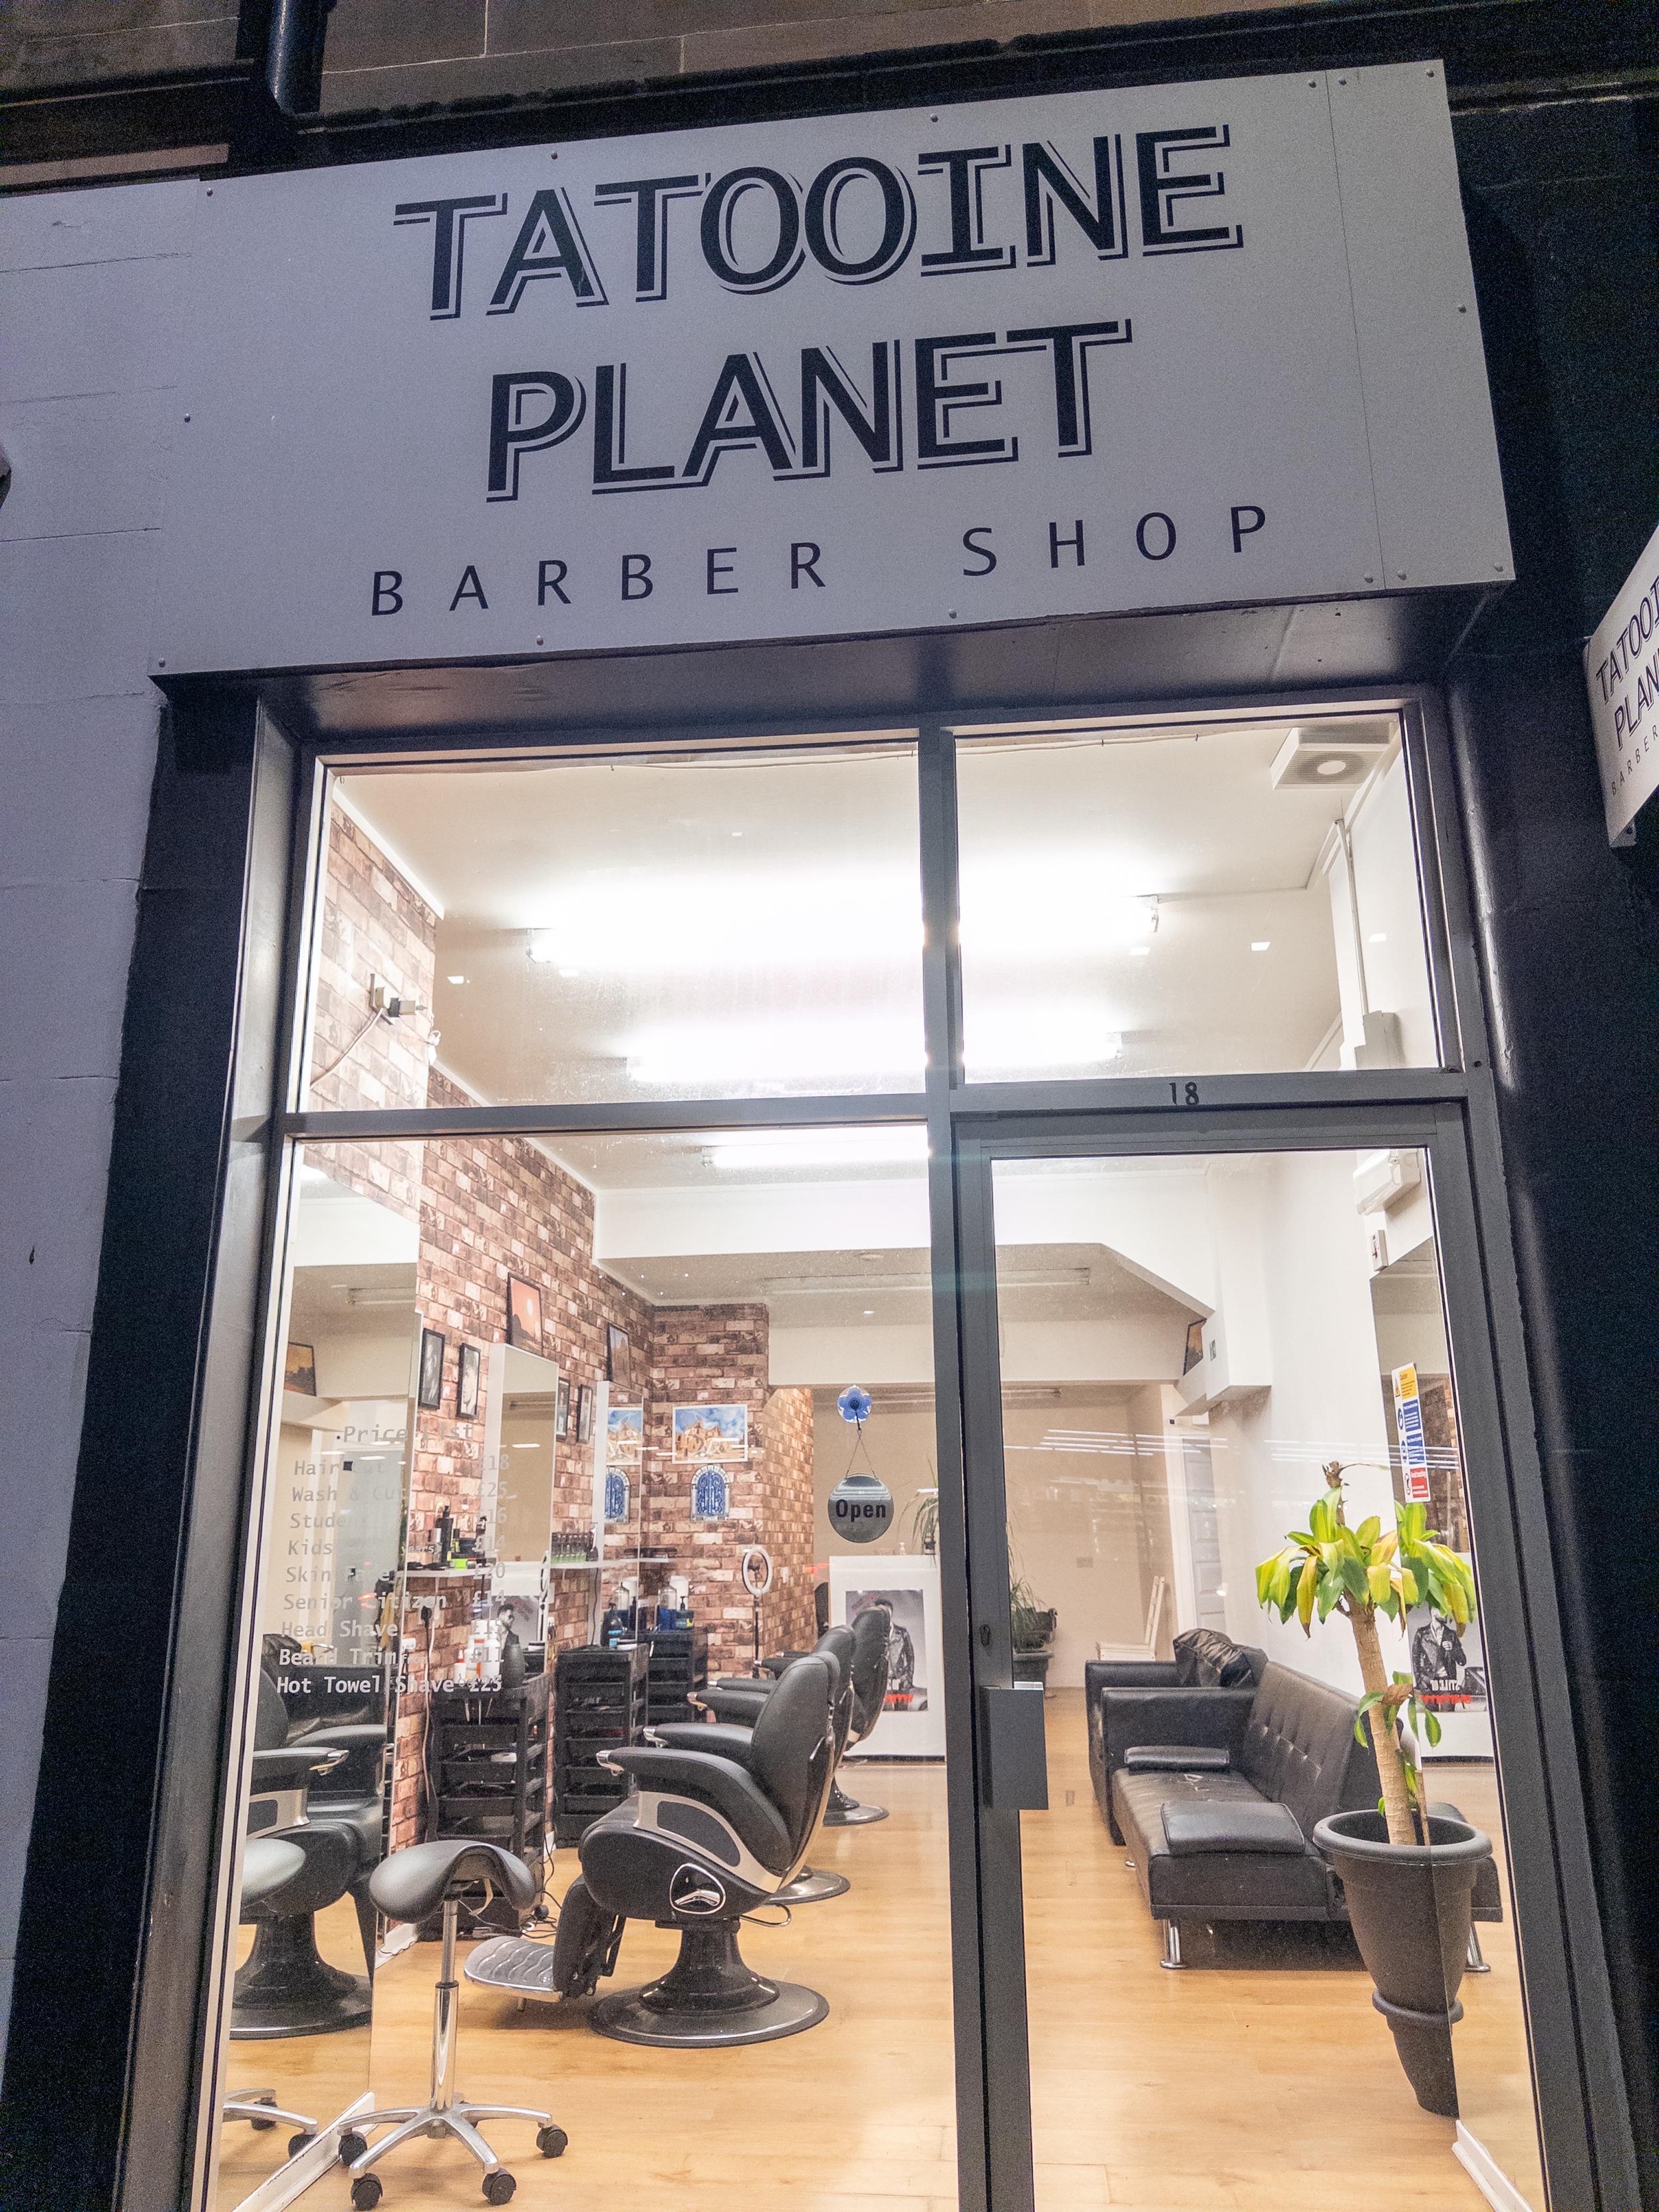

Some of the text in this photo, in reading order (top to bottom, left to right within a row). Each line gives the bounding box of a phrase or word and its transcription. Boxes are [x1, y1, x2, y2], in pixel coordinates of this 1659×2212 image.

[393, 124, 1243, 320] TATOOINE
[486, 319, 1133, 503] PLANET
[371, 505, 1267, 617] BARBER SHOP
[1612, 724, 1658, 796] BARBER
[1169, 1082, 1199, 1105] 18
[344, 1424, 406, 1443] Price
[295, 1460, 339, 1476] Hair
[292, 1486, 337, 1502] Wash
[475, 1508, 508, 1525] 16
[835, 1499, 886, 1523] Open
[288, 1539, 333, 1555] Kids
[286, 1567, 331, 1583] Skin
[473, 1562, 506, 1581] £20
[284, 1593, 353, 1610] Senior
[472, 1589, 507, 1607] £14
[281, 1621, 328, 1639] Head
[340, 1619, 398, 1637] Shave
[352, 1647, 397, 1664] Trim
[277, 1676, 312, 1694] Hot
[325, 1674, 381, 1693] Towel
[394, 1674, 454, 1693] Shave
